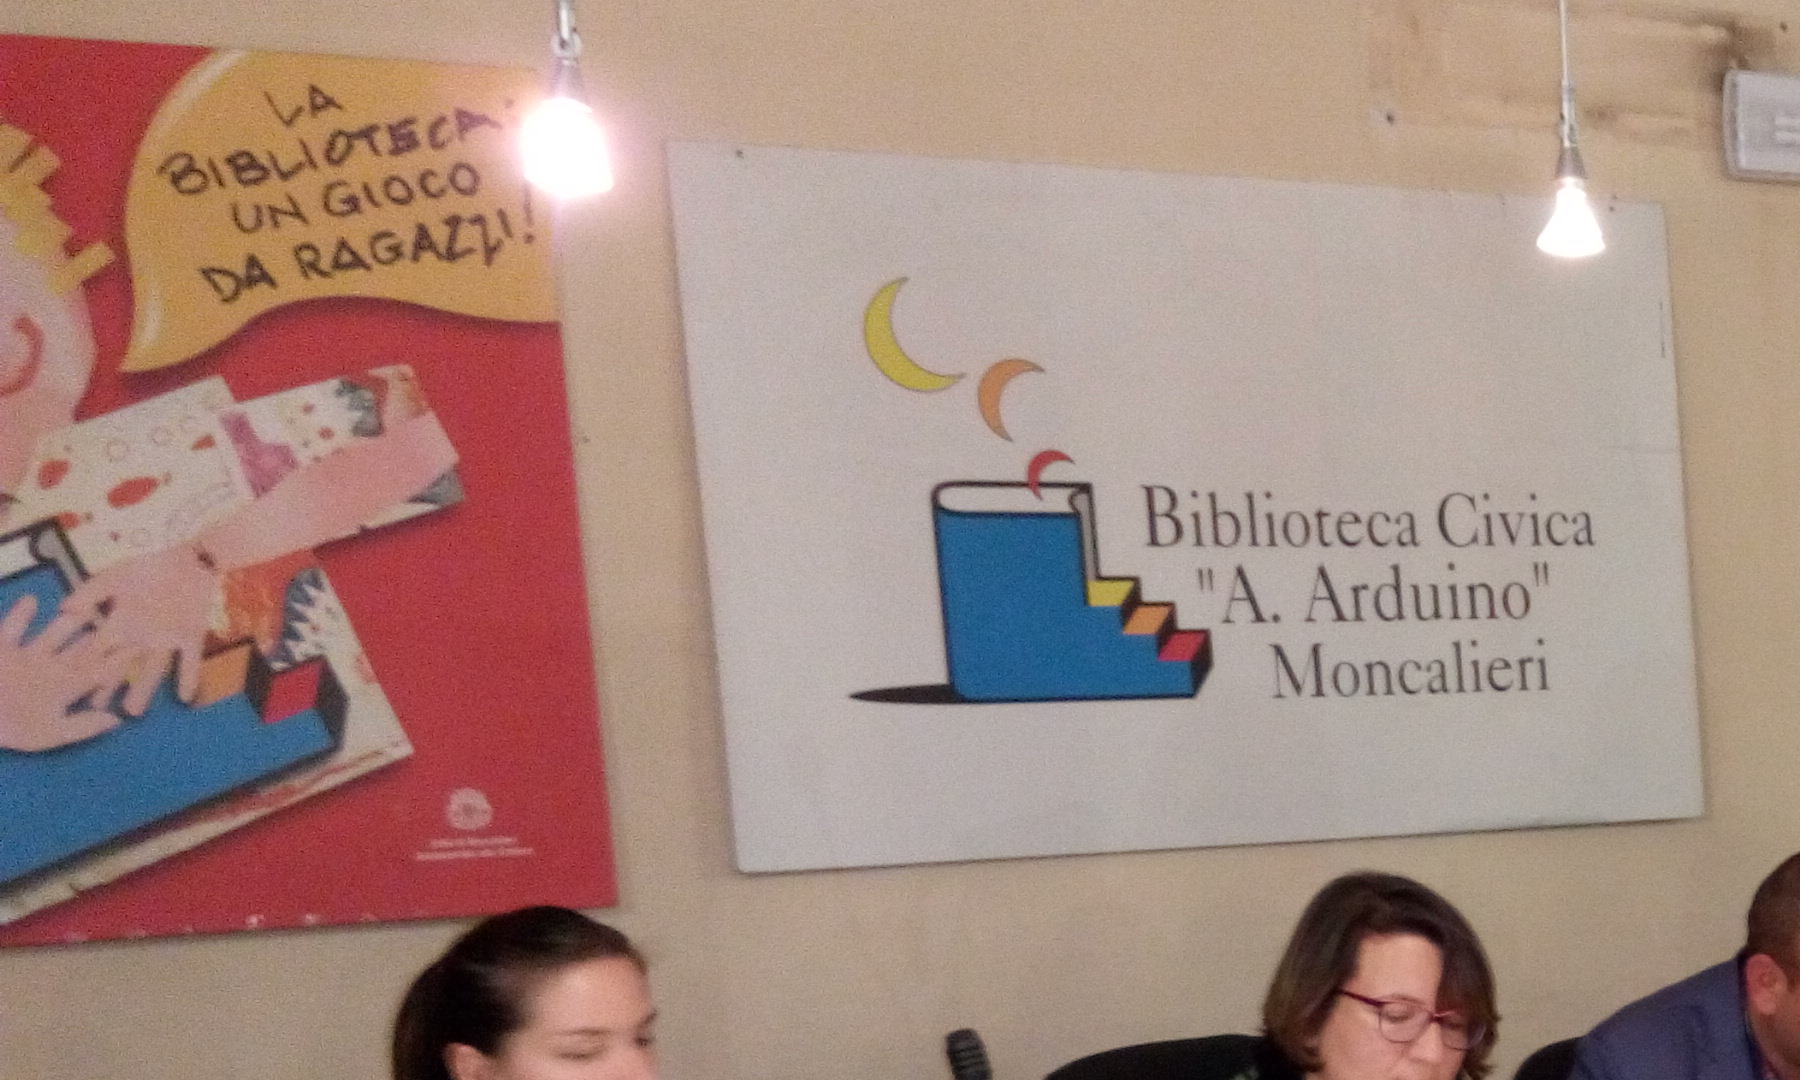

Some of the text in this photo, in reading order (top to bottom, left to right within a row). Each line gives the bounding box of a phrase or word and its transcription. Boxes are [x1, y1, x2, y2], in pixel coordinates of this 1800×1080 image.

[263, 83, 343, 128] LA
[157, 107, 503, 196] BIBLIOTECA
[230, 161, 481, 234] UN GIOCO
[199, 188, 535, 303] DA RAGAZZI!
[1141, 484, 1597, 548] Biblioteca Civica
[1196, 561, 1550, 625] "A. Arduino"
[1269, 637, 1551, 699] Moncalieri
